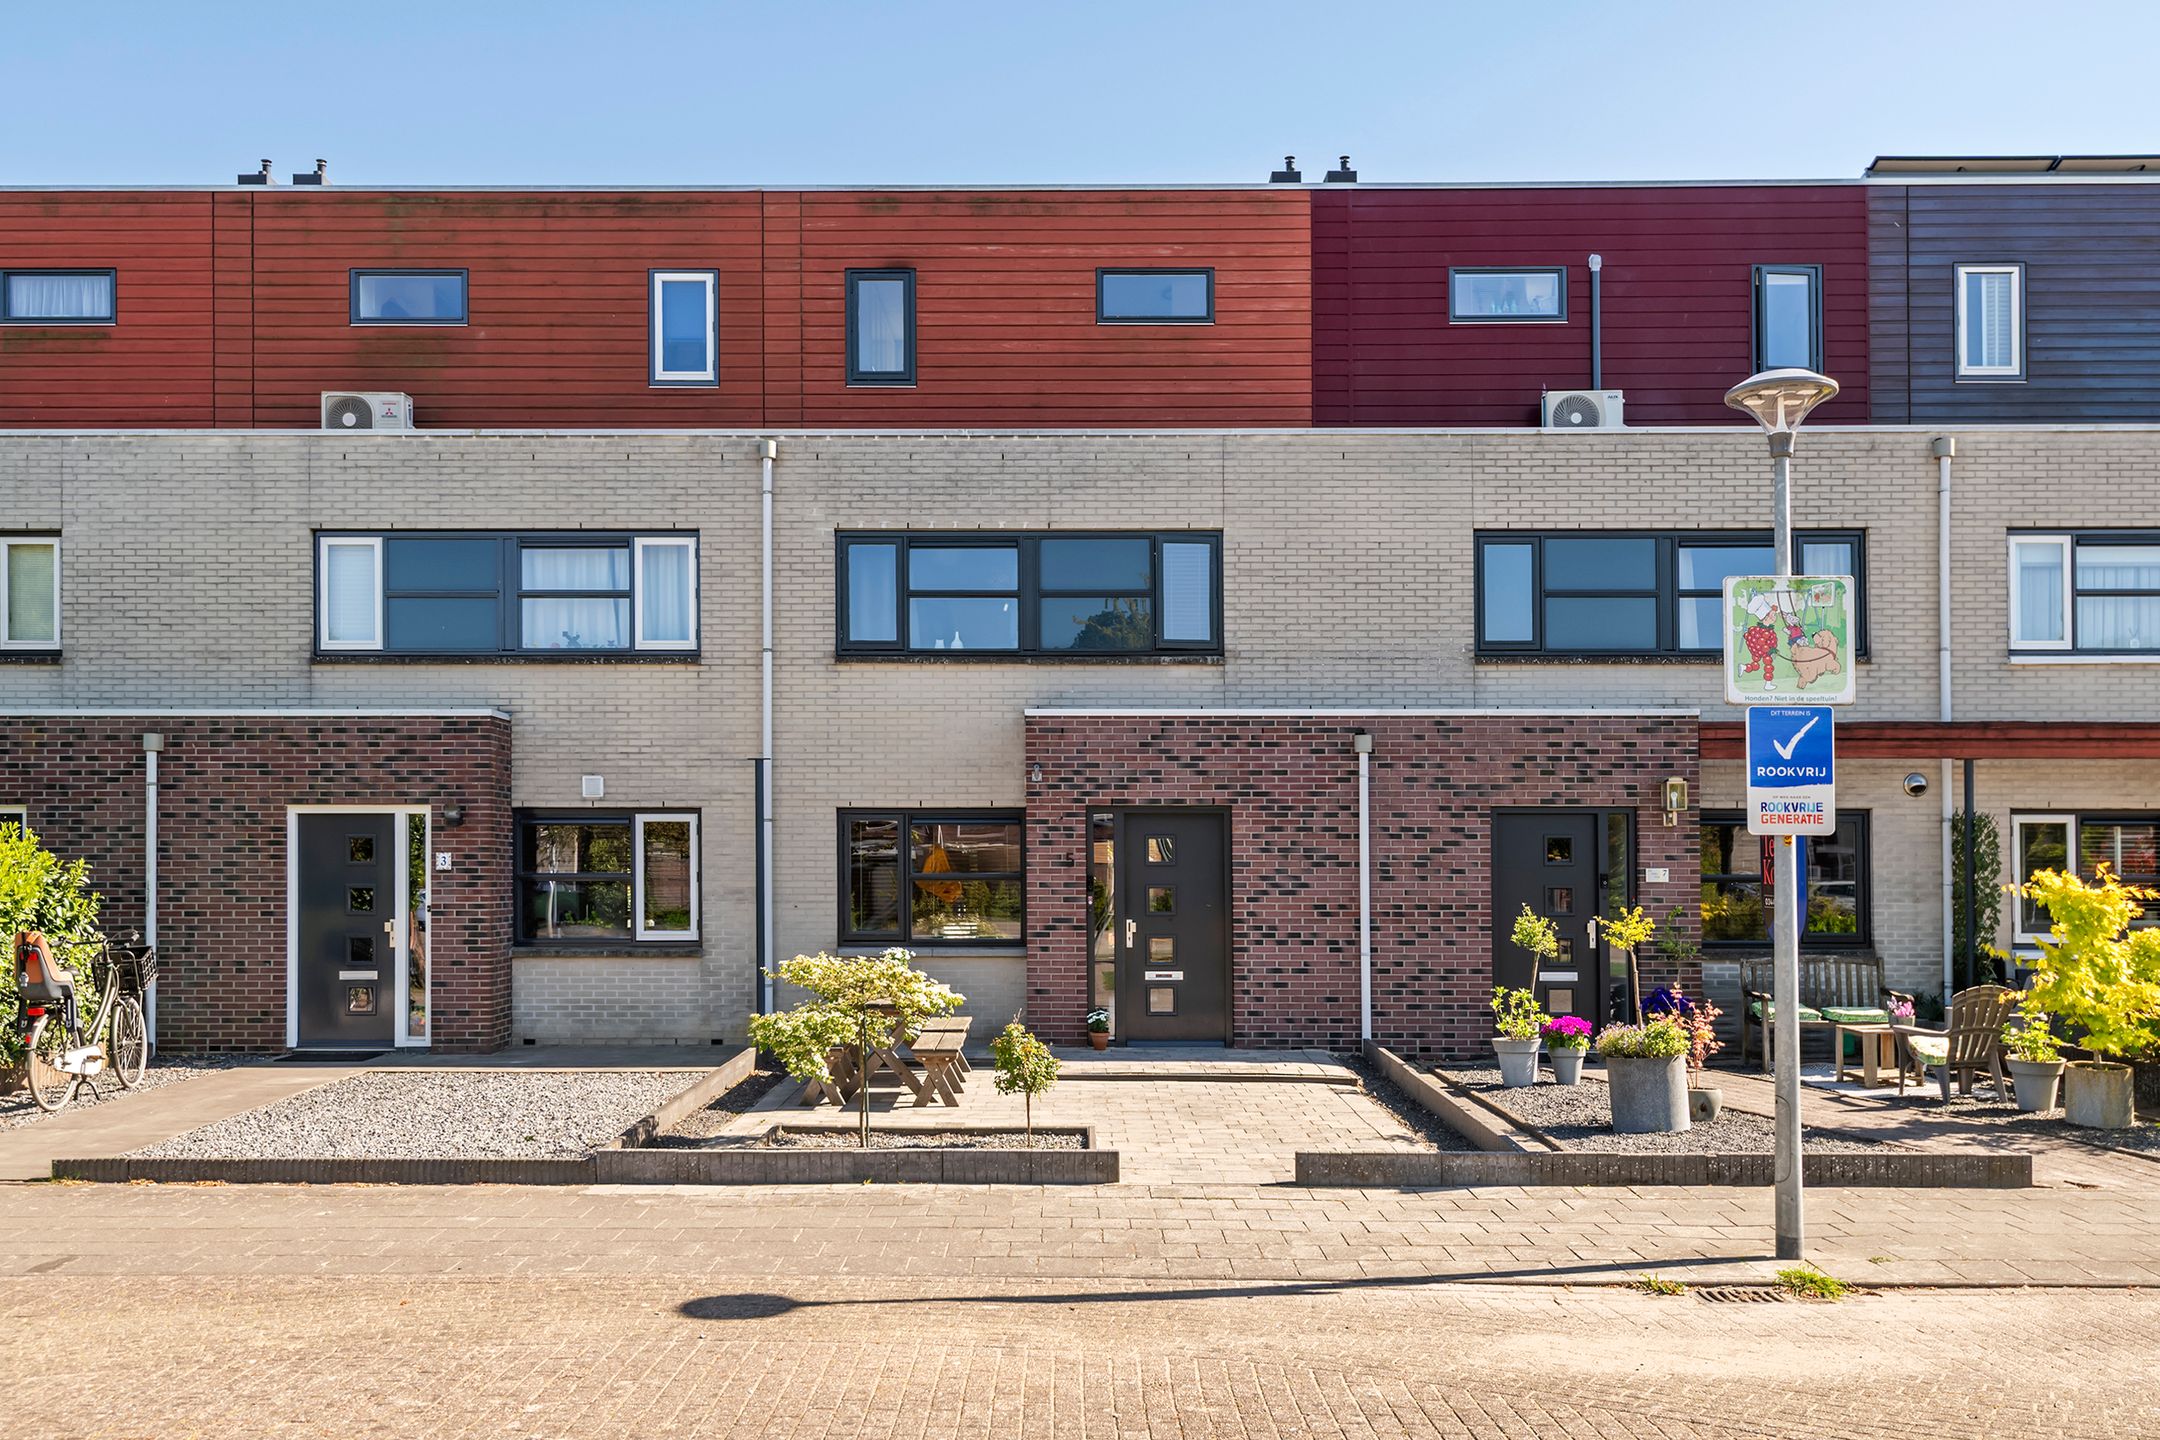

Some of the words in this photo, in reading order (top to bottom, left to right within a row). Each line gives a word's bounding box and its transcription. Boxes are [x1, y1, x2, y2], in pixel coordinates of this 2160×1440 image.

[1806, 695, 1838, 703] speeltuin!
[1757, 766, 1827, 777] ROOKVRIJ
[1760, 801, 1824, 812] ROOKVRIJE
[1760, 813, 1824, 824] GENERATIE
[440, 855, 447, 866] 3
[1066, 852, 1075, 867] 5
